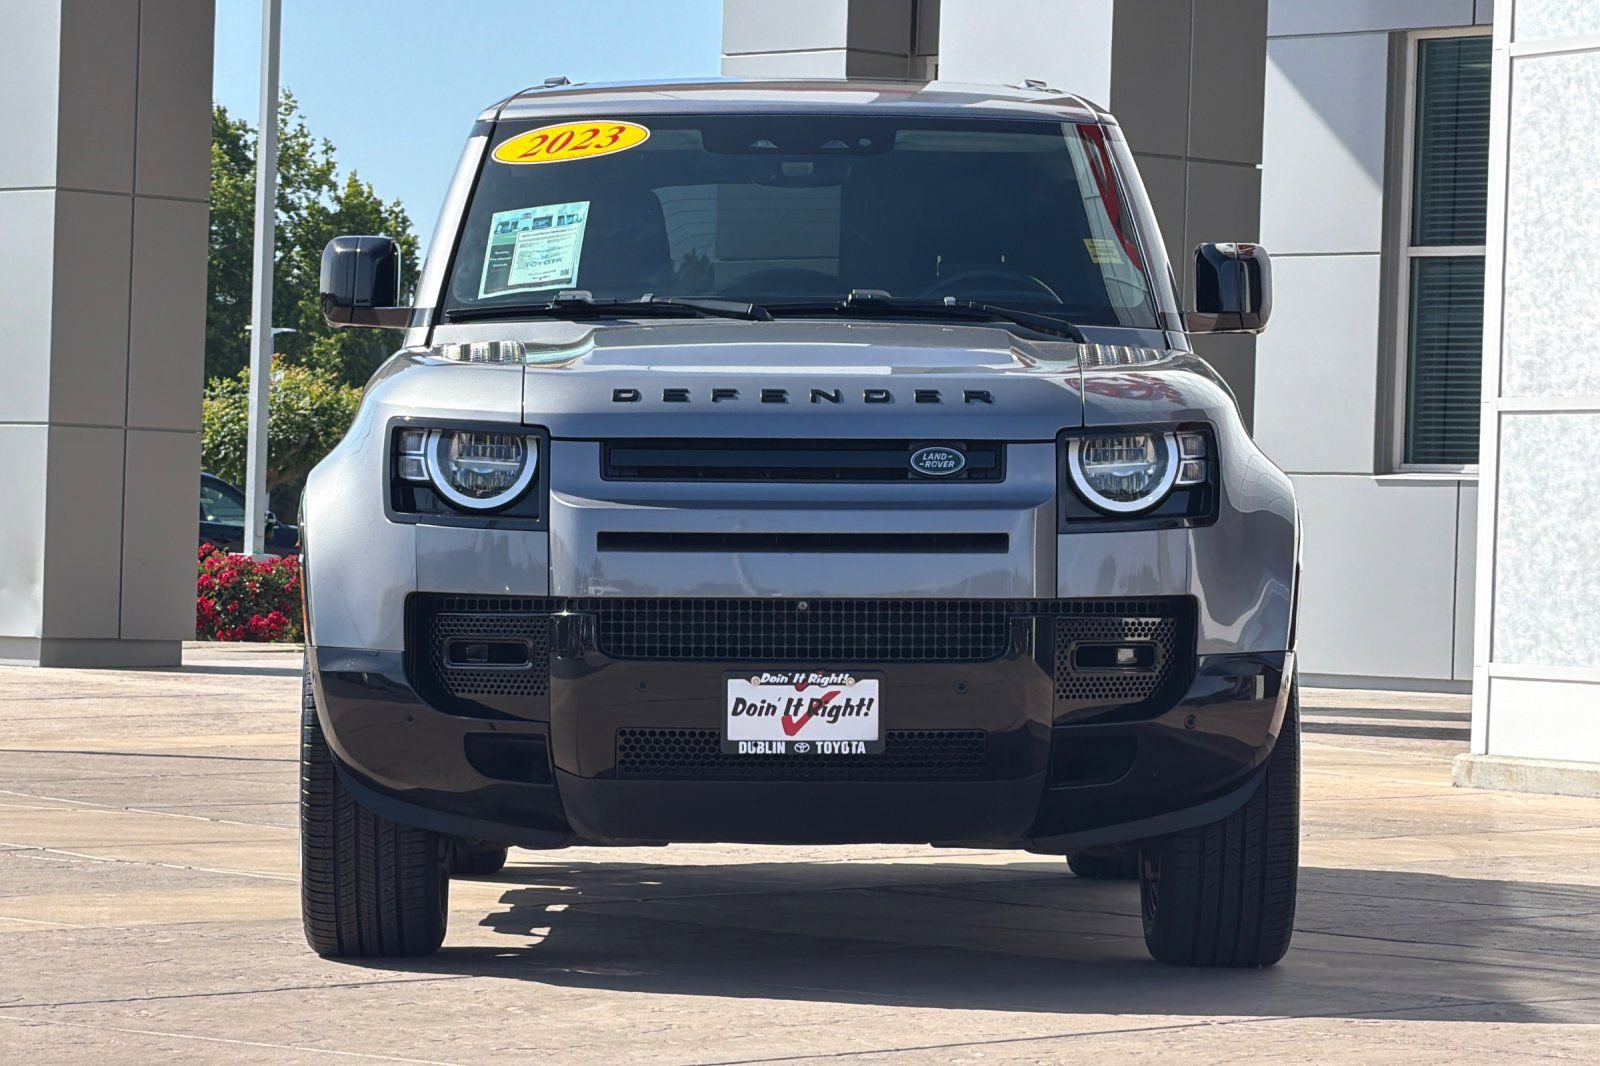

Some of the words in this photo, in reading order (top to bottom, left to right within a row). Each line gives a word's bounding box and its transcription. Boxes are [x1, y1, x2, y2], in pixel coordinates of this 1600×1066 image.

[518, 126, 626, 158] 2023
[525, 257, 562, 268] TOYOTA
[611, 388, 994, 403] DEFENDER
[760, 672, 792, 684] Doin'
[793, 672, 806, 684] It
[807, 673, 850, 687] Right!
[731, 697, 782, 717] Doin'
[783, 697, 804, 717] It
[807, 697, 874, 723] Right!
[738, 741, 786, 754] DUBLIN
[816, 741, 866, 754] TOYOTA
